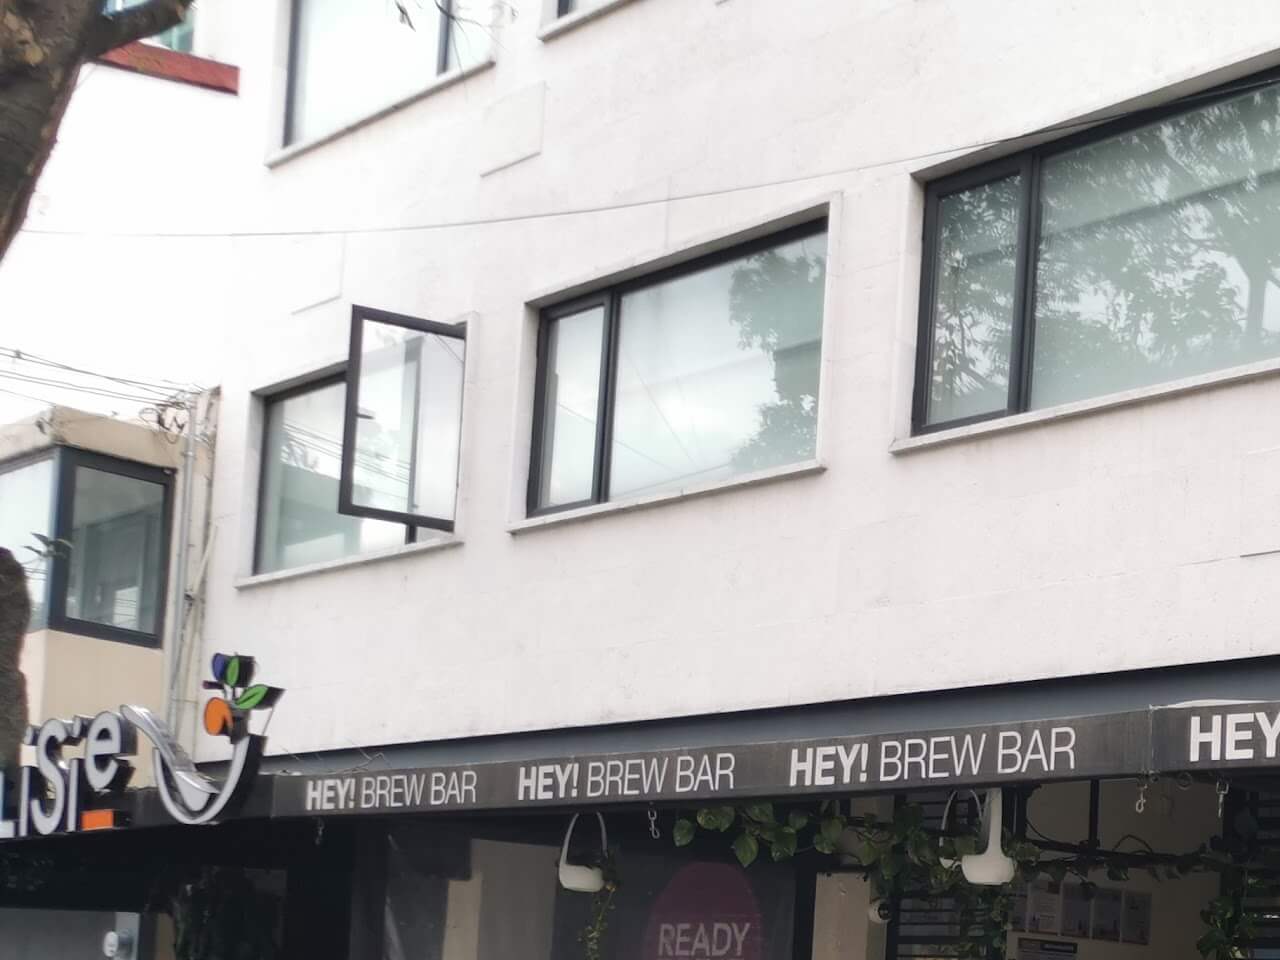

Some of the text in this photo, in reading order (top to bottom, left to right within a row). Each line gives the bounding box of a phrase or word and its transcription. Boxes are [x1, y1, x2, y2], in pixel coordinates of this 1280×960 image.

[518, 753, 736, 801] HEY! BREW BAR
[789, 726, 1077, 787] HEY! BREW BAR
[306, 771, 477, 811] HEY! BREW BAR
[658, 922, 750, 956] READY
